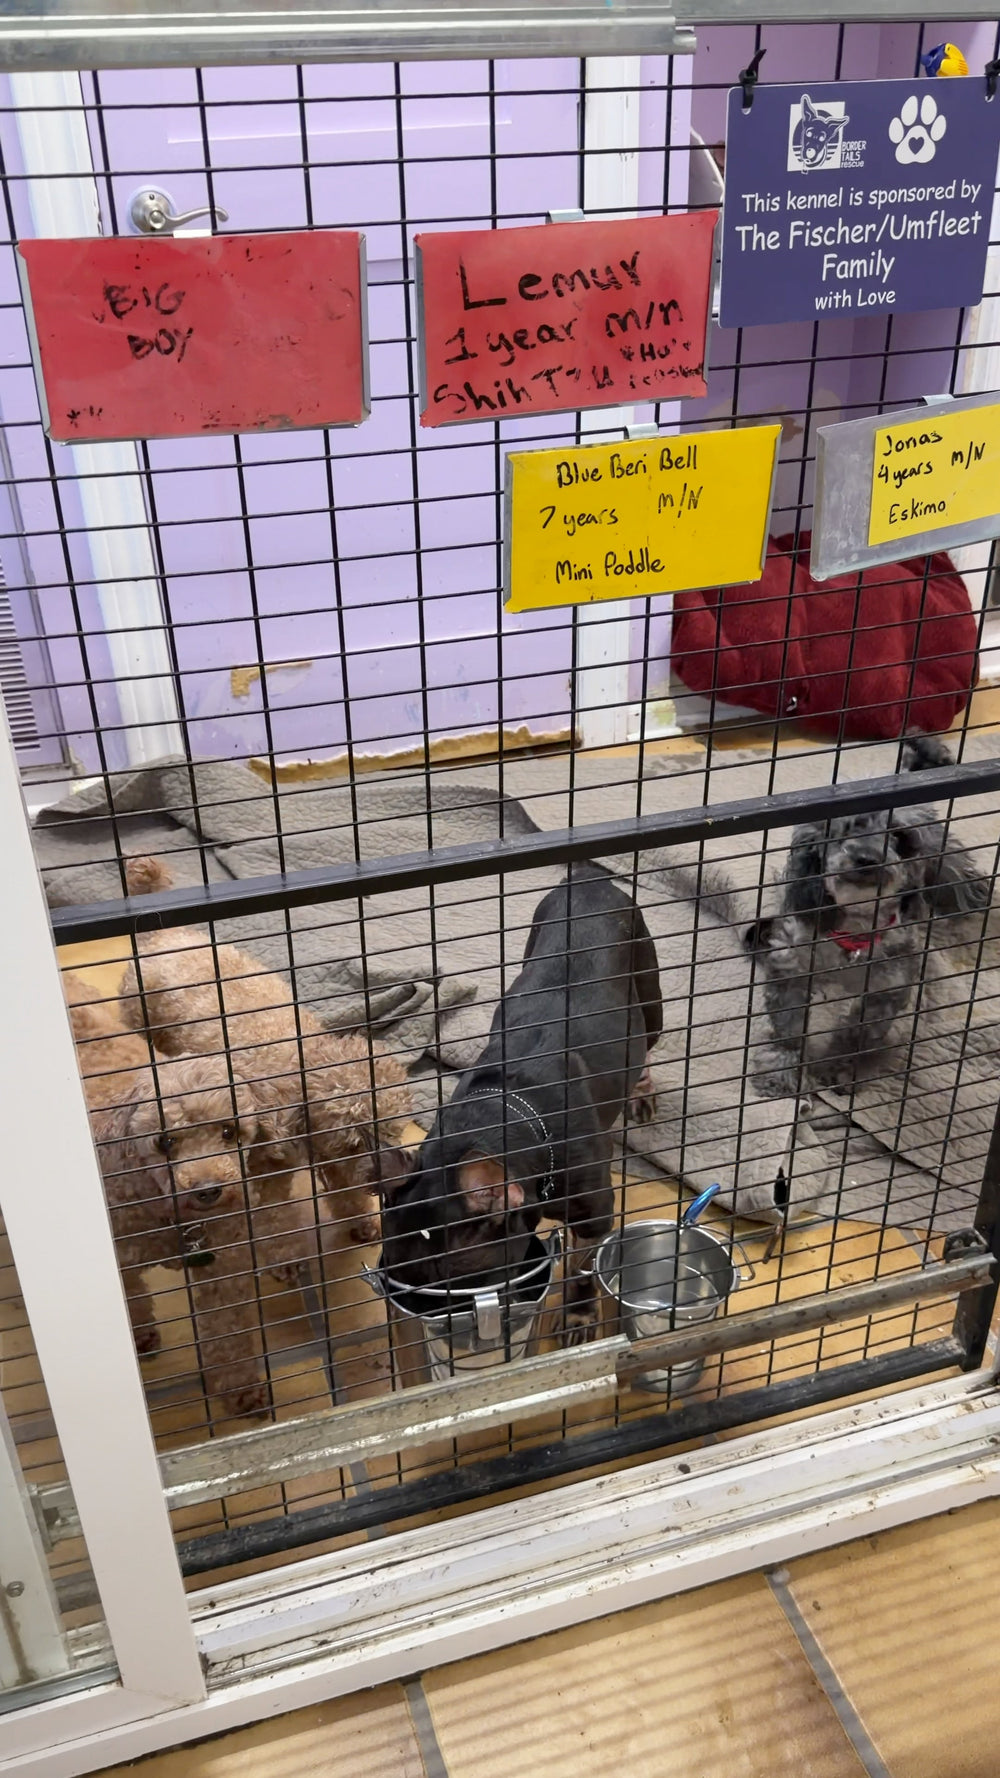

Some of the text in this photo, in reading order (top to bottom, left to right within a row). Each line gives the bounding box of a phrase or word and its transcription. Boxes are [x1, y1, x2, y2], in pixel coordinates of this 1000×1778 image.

[841, 140, 867, 151] BORDER
[841, 151, 861, 161] TAILS
[840, 160, 865, 168] rescue
[741, 179, 982, 213] This kennel is sponsored by
[735, 210, 983, 251] The Fischer/Umfleet
[457, 251, 641, 310] Lemur
[821, 249, 895, 283] Family
[104, 281, 186, 319] BIG
[815, 288, 896, 310] with Love
[127, 327, 194, 363] BOY
[444, 326, 478, 365] 1
[486, 318, 578, 367] year
[433, 375, 533, 414] Shih
[883, 430, 944, 456] Jonas
[556, 445, 698, 489] Blue Beri Bell
[877, 464, 889, 483] 4
[893, 460, 934, 489] years
[539, 506, 557, 529] 7
[563, 508, 619, 536] years
[888, 499, 947, 524] Eskimo
[555, 547, 666, 584] Mini Poddle
